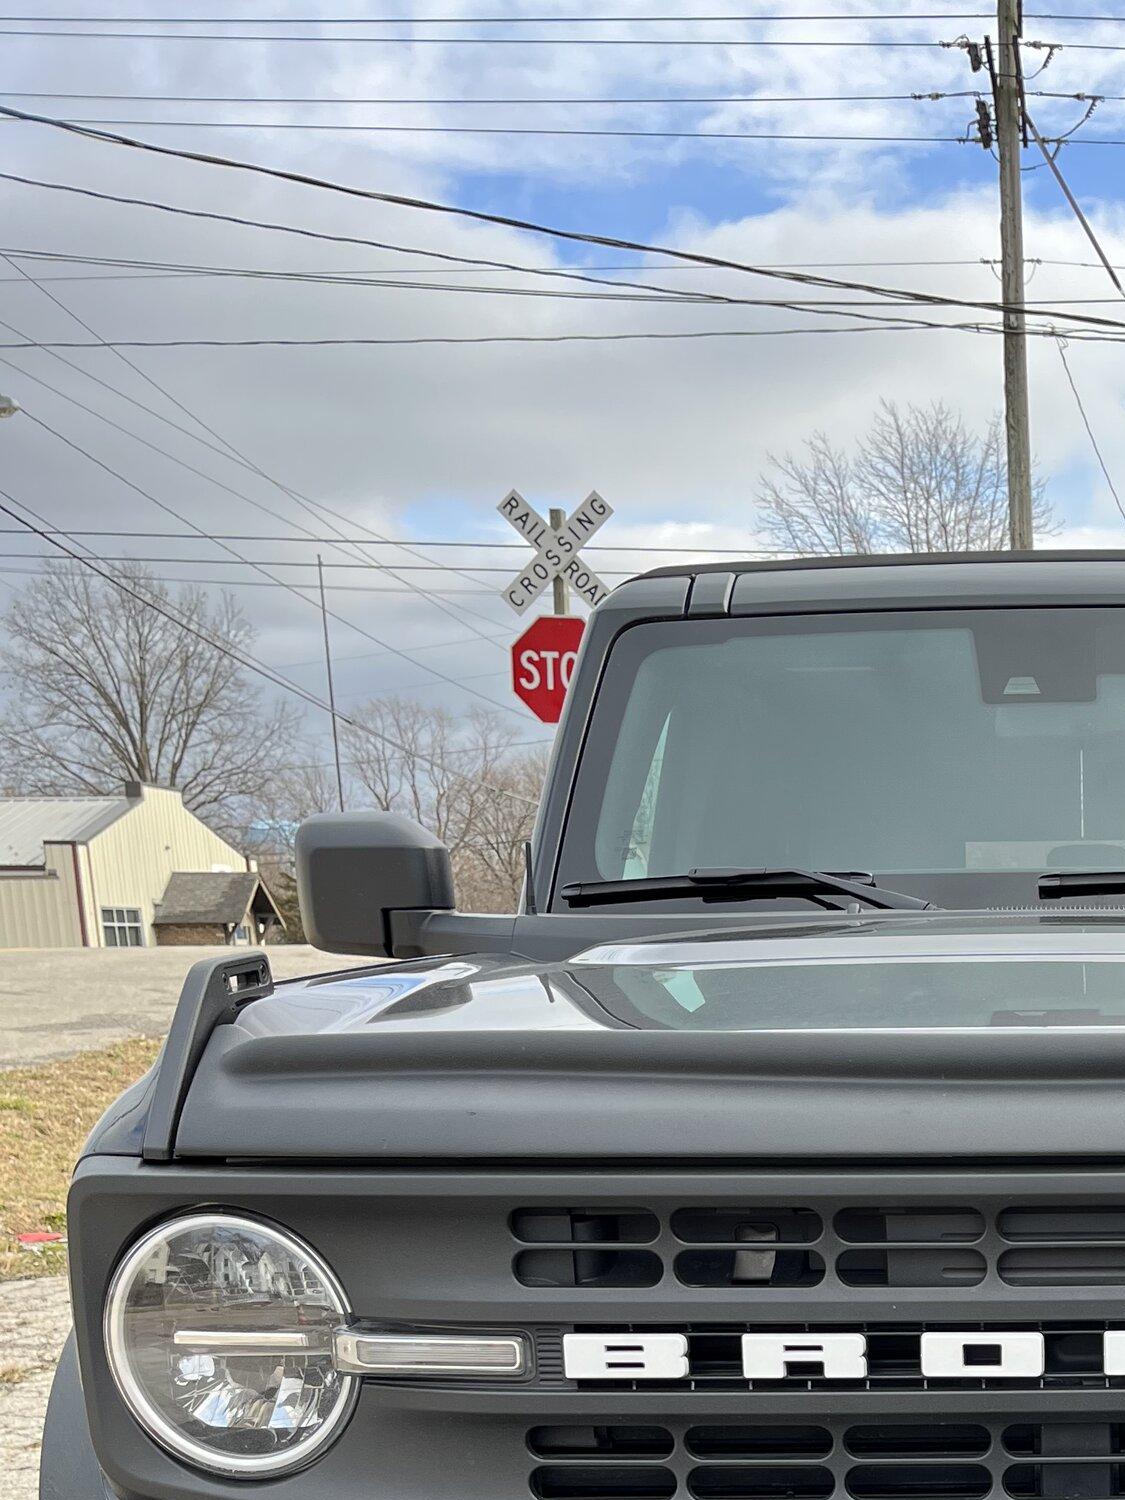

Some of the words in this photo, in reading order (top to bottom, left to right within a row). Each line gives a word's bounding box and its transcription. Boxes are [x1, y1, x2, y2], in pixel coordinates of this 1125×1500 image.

[502, 496, 547, 548] RAIL
[508, 498, 606, 608] CROSSING
[519, 650, 578, 690] STO
